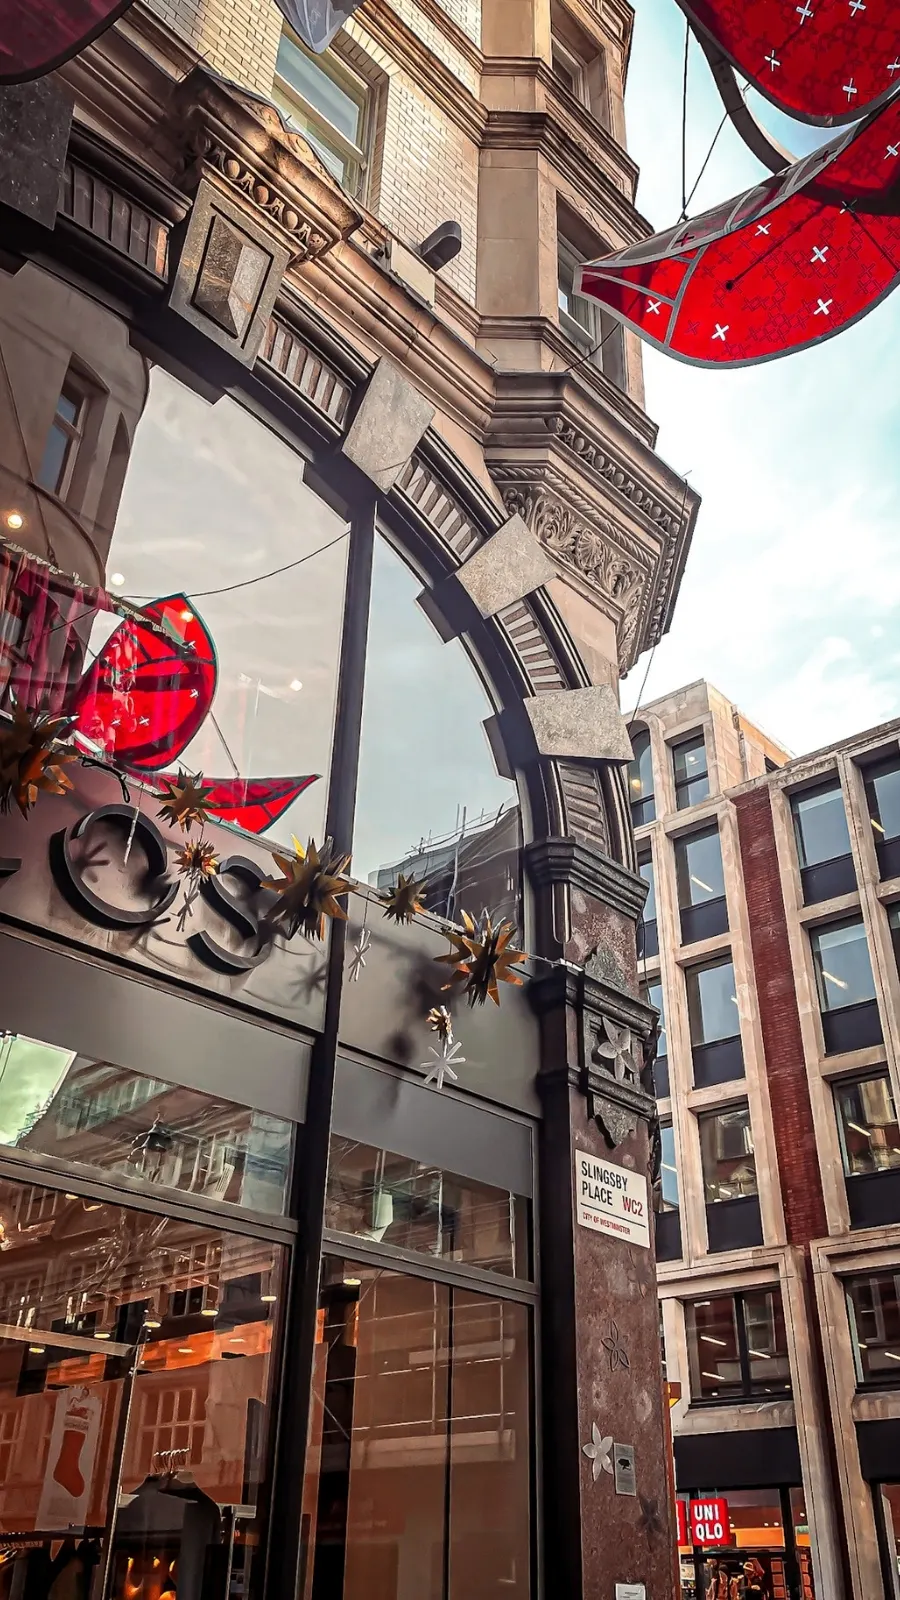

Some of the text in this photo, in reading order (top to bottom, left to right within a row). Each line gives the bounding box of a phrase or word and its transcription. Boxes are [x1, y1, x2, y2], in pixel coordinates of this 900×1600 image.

[0, 803, 273, 975] OS
[581, 1160, 628, 1192] SLINGSBY
[582, 1181, 644, 1218] PLACE WC2
[583, 1212, 592, 1220] CITY
[600, 1219, 630, 1235] WESTMINSTER
[693, 1504, 720, 1521] UNI
[695, 1522, 724, 1542] QLO
